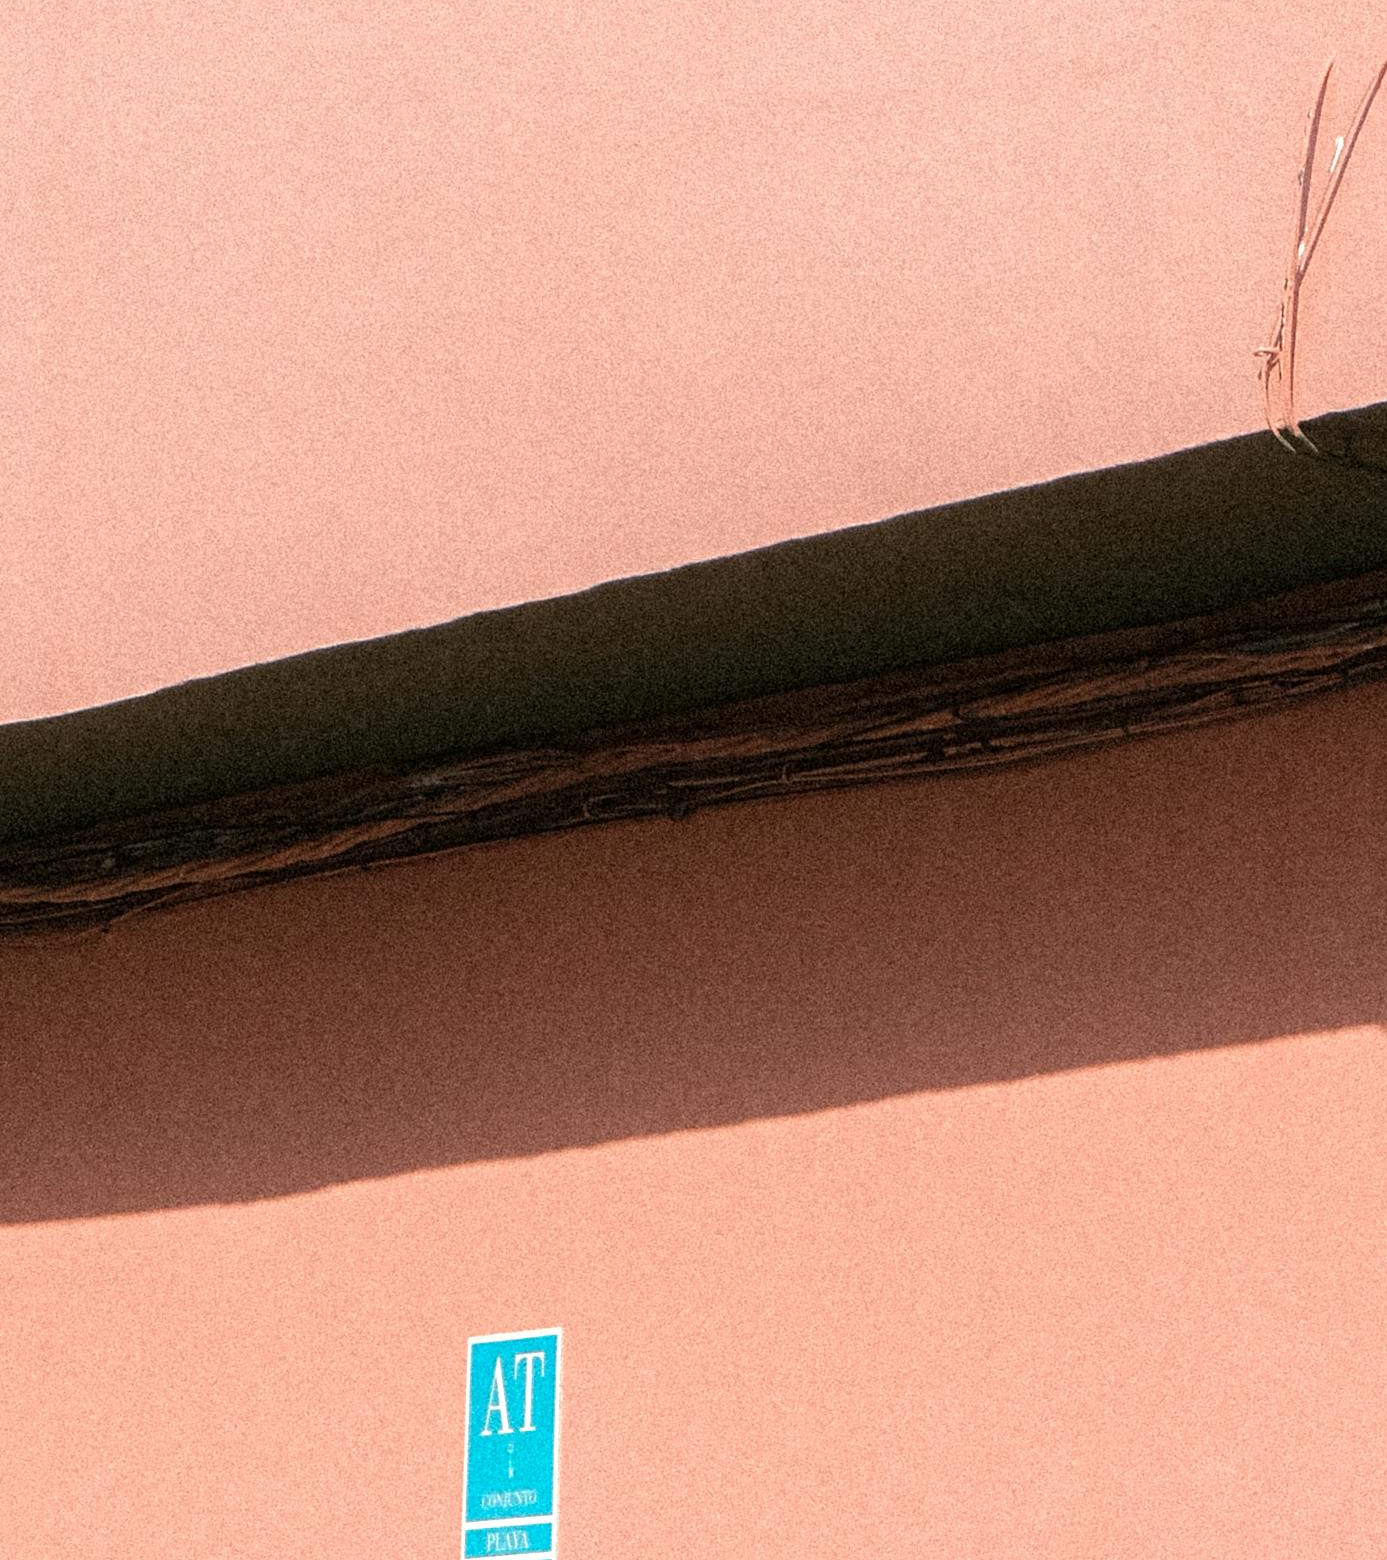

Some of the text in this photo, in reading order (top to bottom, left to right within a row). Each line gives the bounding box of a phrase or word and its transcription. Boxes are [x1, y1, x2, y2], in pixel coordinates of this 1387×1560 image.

[480, 1351, 545, 1437] AT
[481, 1489, 537, 1509] CONJUNTO
[486, 1530, 529, 1553] PLAYA
